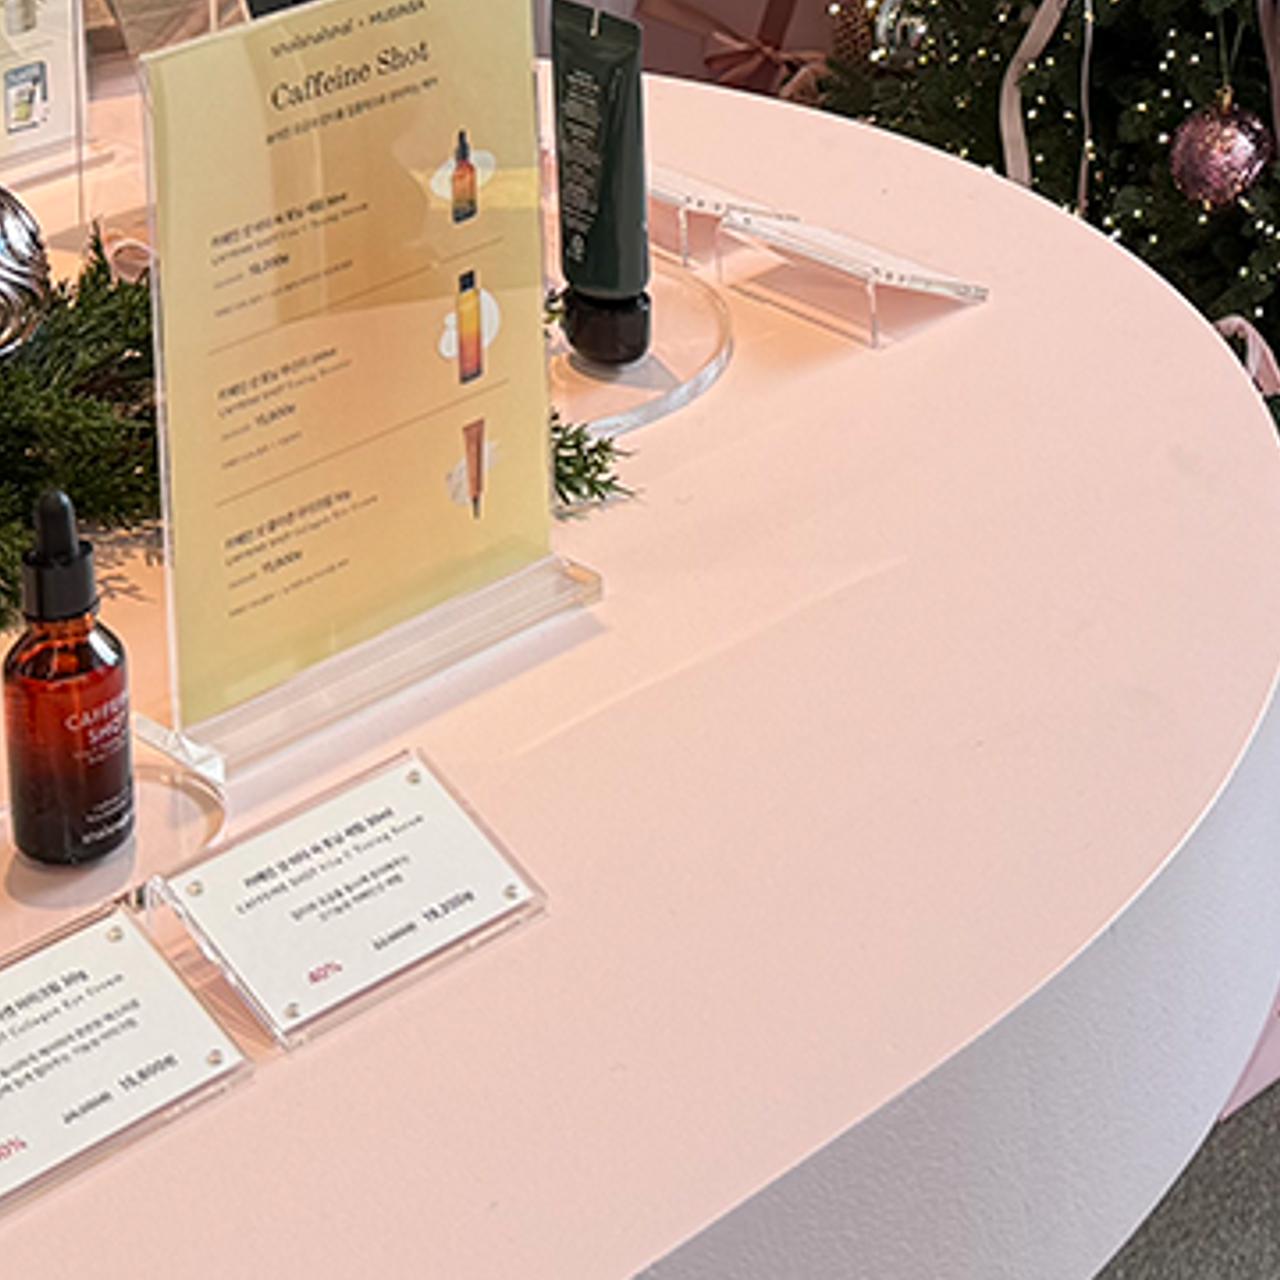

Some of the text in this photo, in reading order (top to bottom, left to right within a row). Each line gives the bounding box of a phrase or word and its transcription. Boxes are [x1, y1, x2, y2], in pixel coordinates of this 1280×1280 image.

[270, 63, 372, 111] Caffeine
[376, 42, 430, 76] Shot
[306, 960, 344, 985] 40%
[118, 1053, 179, 1092] 15,600원
